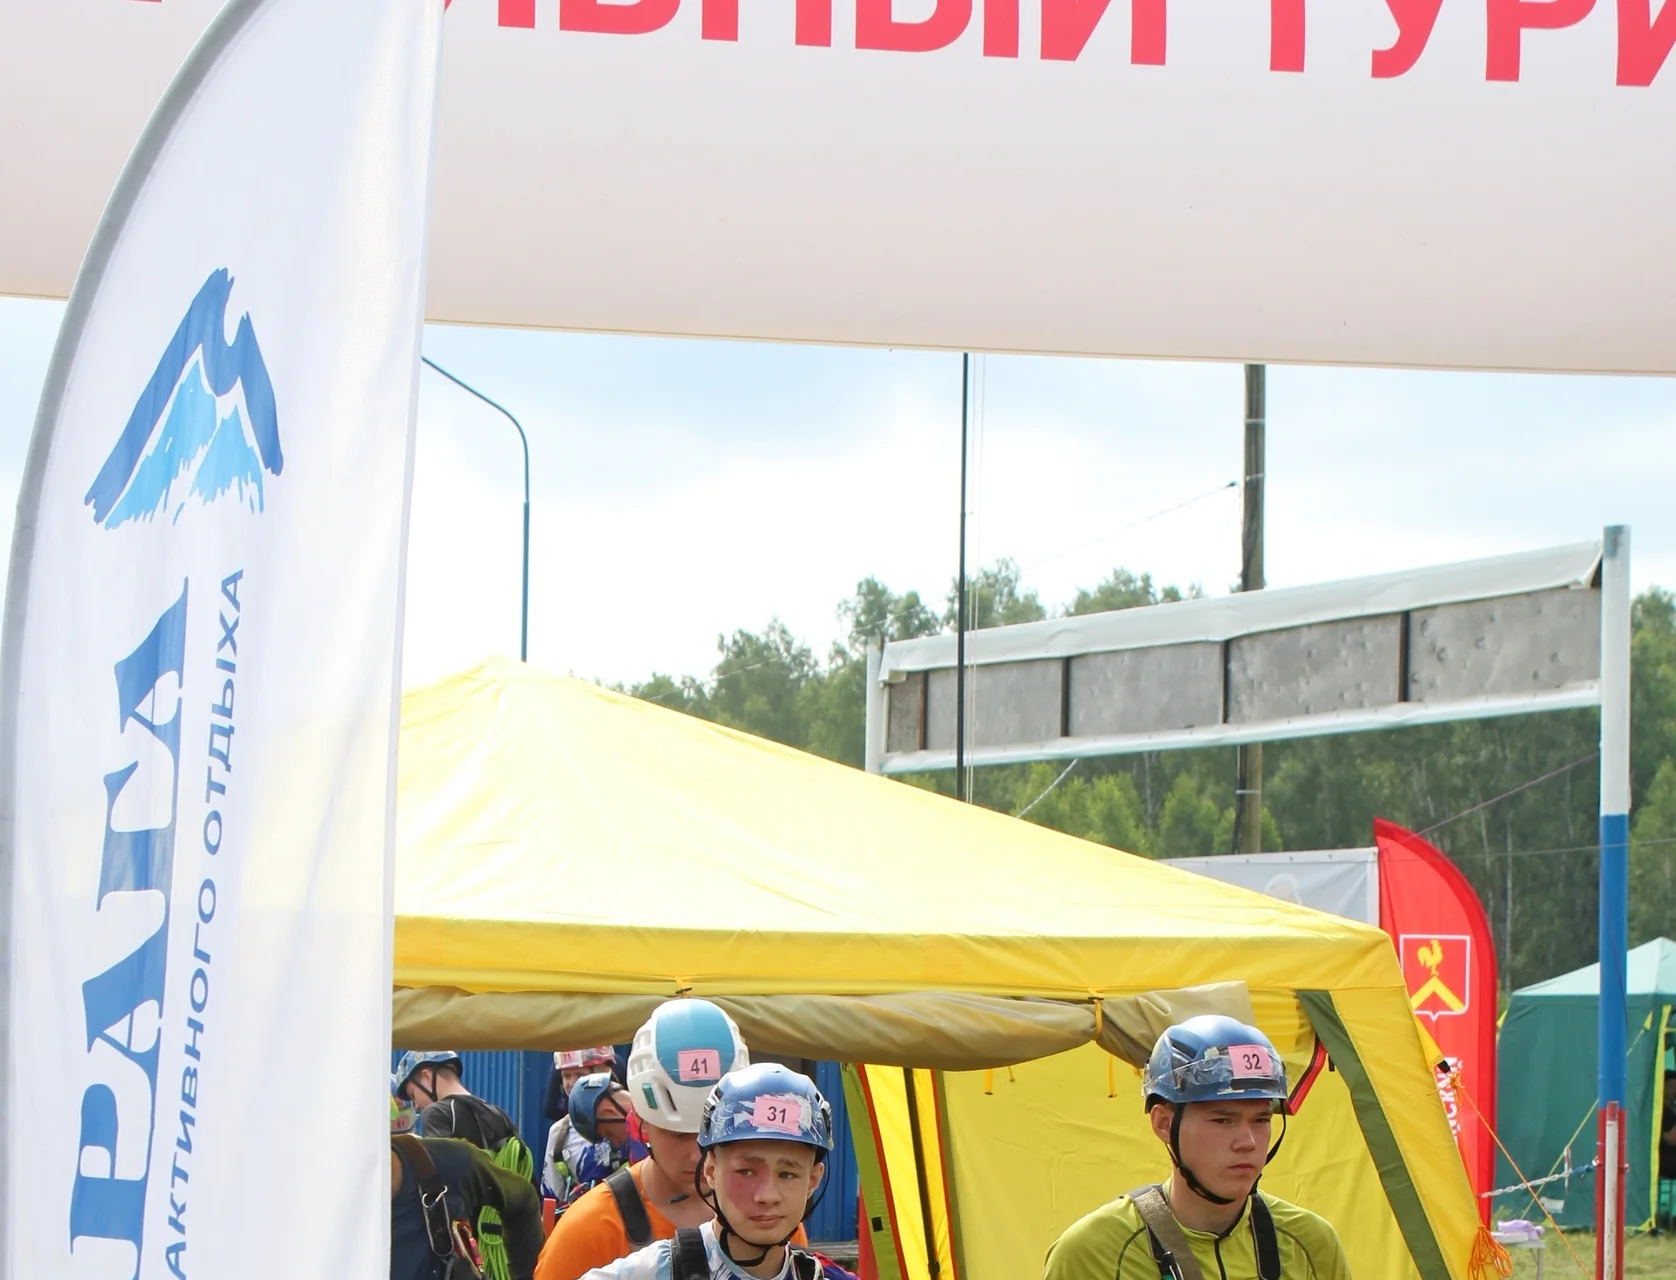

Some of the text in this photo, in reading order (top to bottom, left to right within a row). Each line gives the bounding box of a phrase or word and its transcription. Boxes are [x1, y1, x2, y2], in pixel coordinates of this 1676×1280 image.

[202, 568, 244, 857] ОТДЫХА
[690, 1058, 709, 1074] 41
[1242, 1053, 1263, 1070] 32
[767, 1106, 786, 1124] 31
